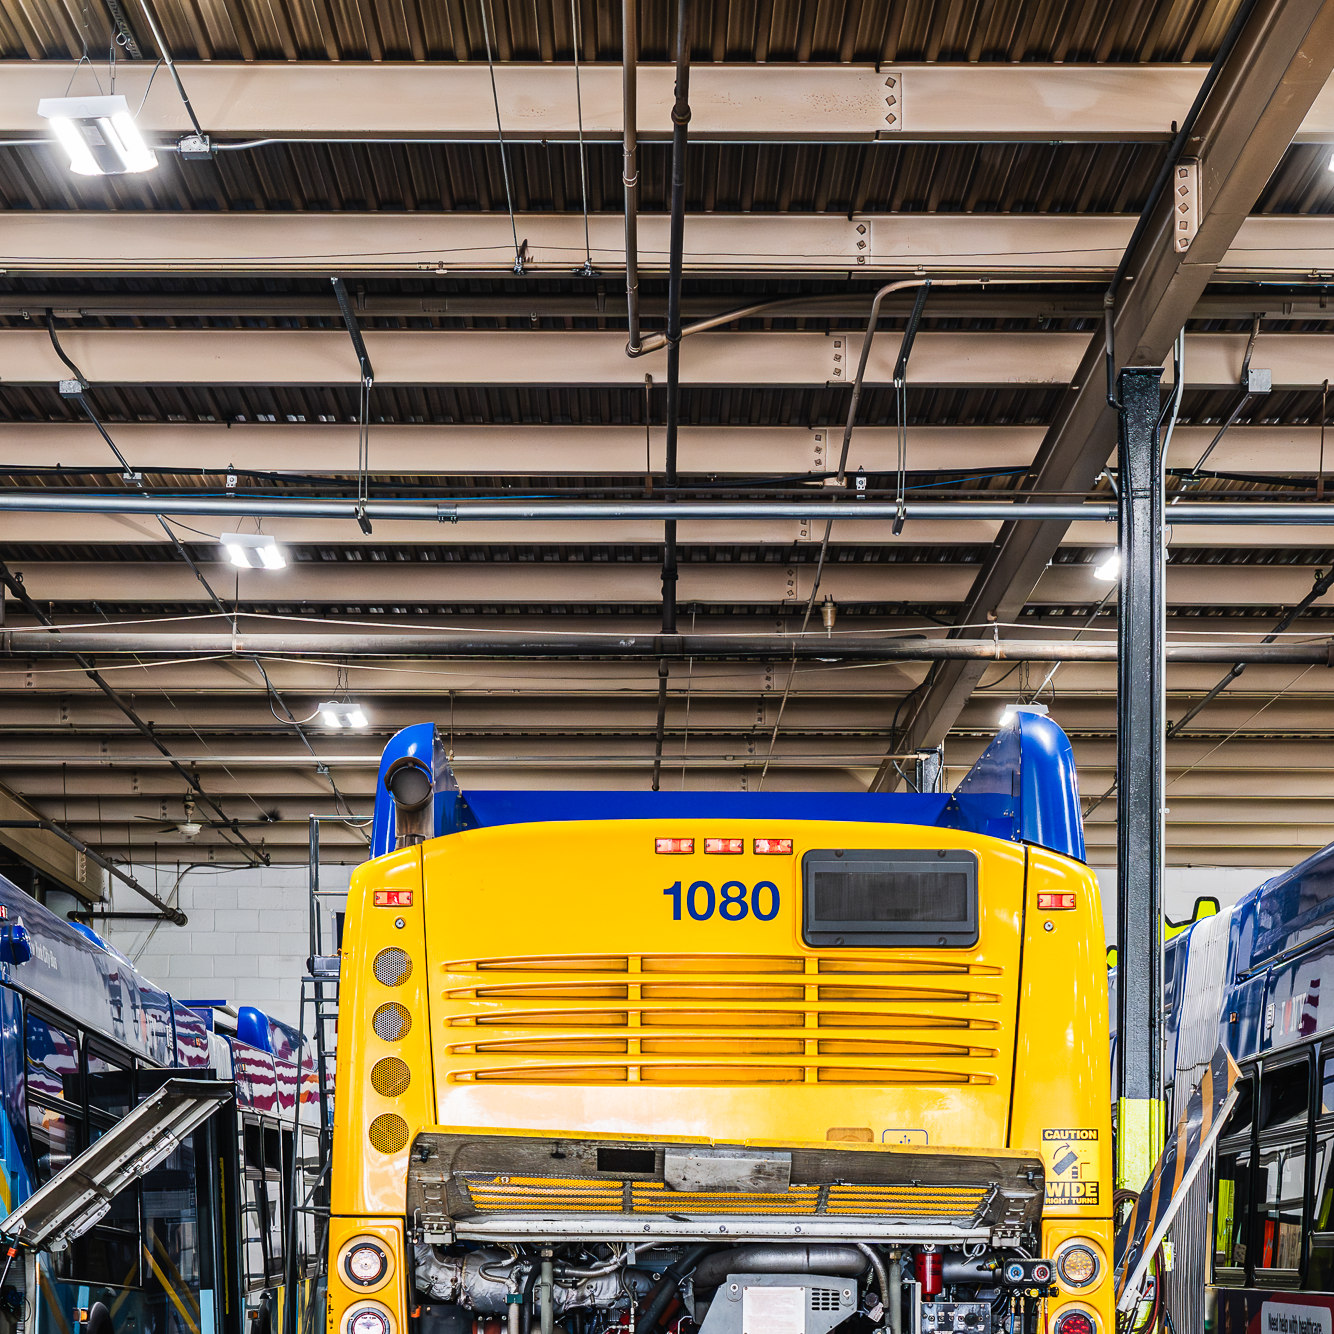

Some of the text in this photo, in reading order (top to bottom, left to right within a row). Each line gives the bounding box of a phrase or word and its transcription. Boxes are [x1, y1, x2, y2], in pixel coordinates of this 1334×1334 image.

[663, 880, 781, 921] 1080
[1044, 1130, 1097, 1140] CAUTION
[1045, 1183, 1098, 1197] WIDE
[1268, 1313, 1278, 1331] Need
[1288, 1314, 1298, 1334] with
